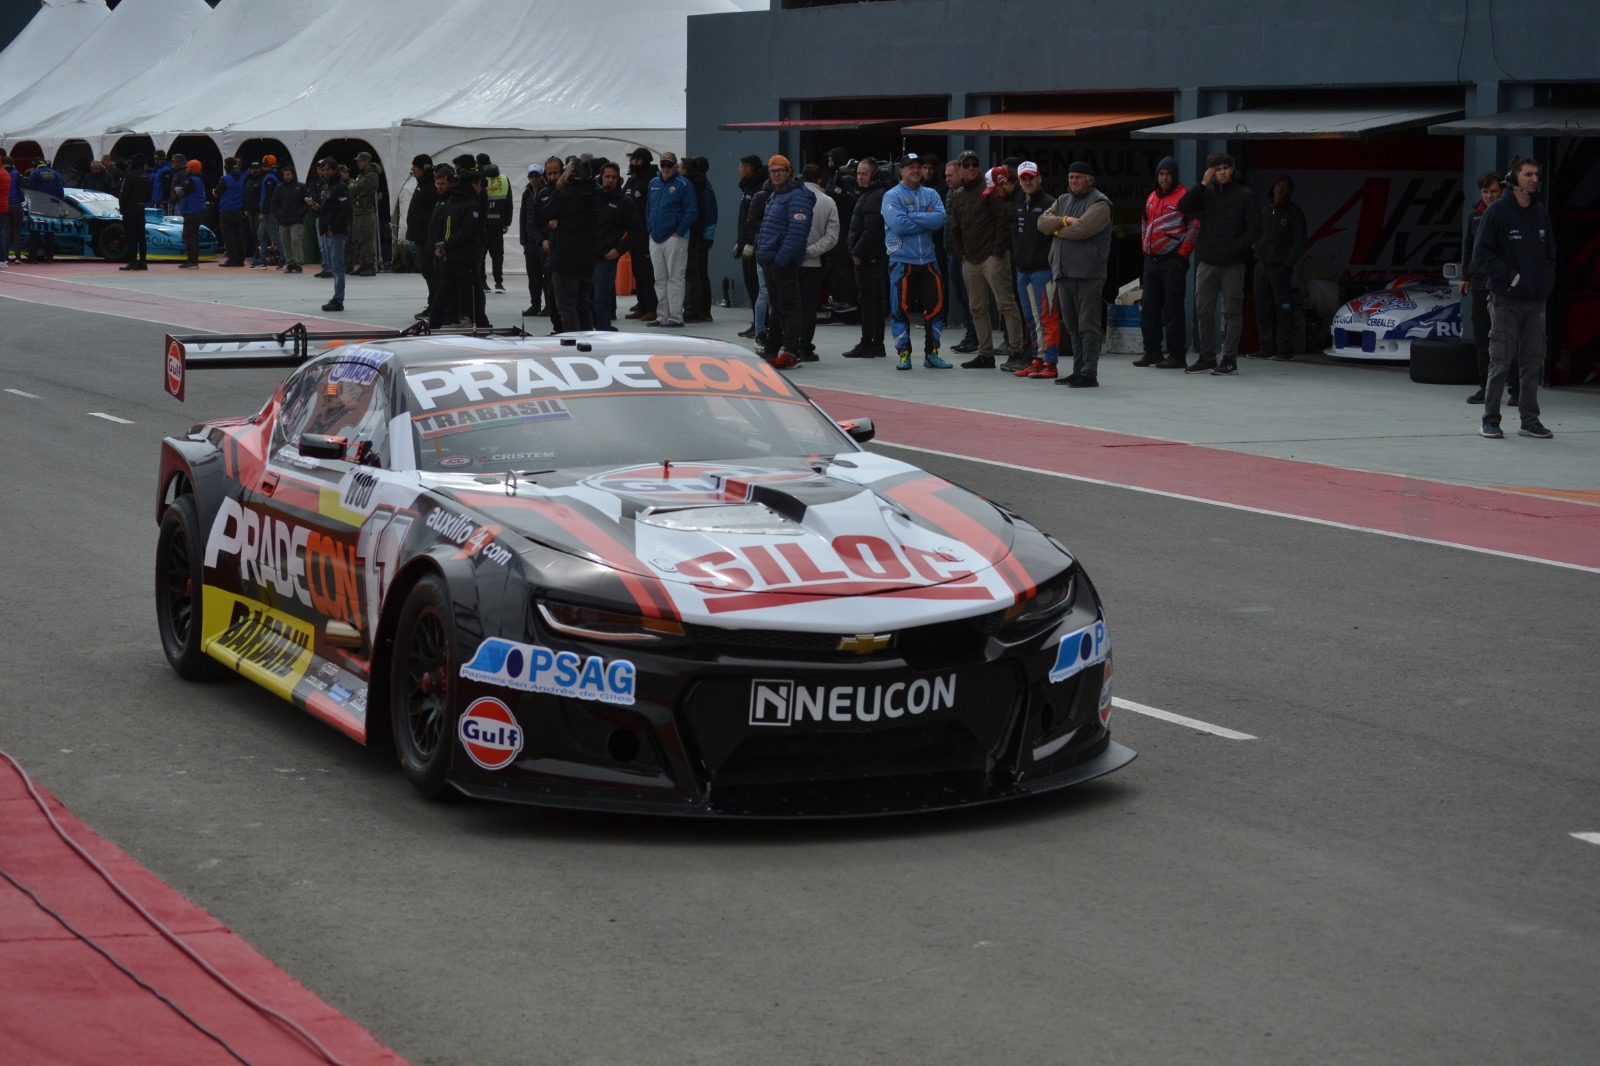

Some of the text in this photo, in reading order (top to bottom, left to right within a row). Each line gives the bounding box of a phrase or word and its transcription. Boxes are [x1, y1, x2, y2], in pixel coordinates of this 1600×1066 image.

[1367, 318, 1396, 328] CEREALES
[405, 354, 793, 409] PRADECON
[416, 400, 567, 431] TRABASIL
[492, 451, 555, 461] CRISTEM
[204, 496, 363, 630] PRADECON
[356, 503, 420, 650] 11
[461, 669, 633, 703] Papelera San Andrés de Giles
[529, 648, 633, 695] PSAG
[794, 673, 957, 722] NEUCON
[463, 719, 518, 747] Gulf
